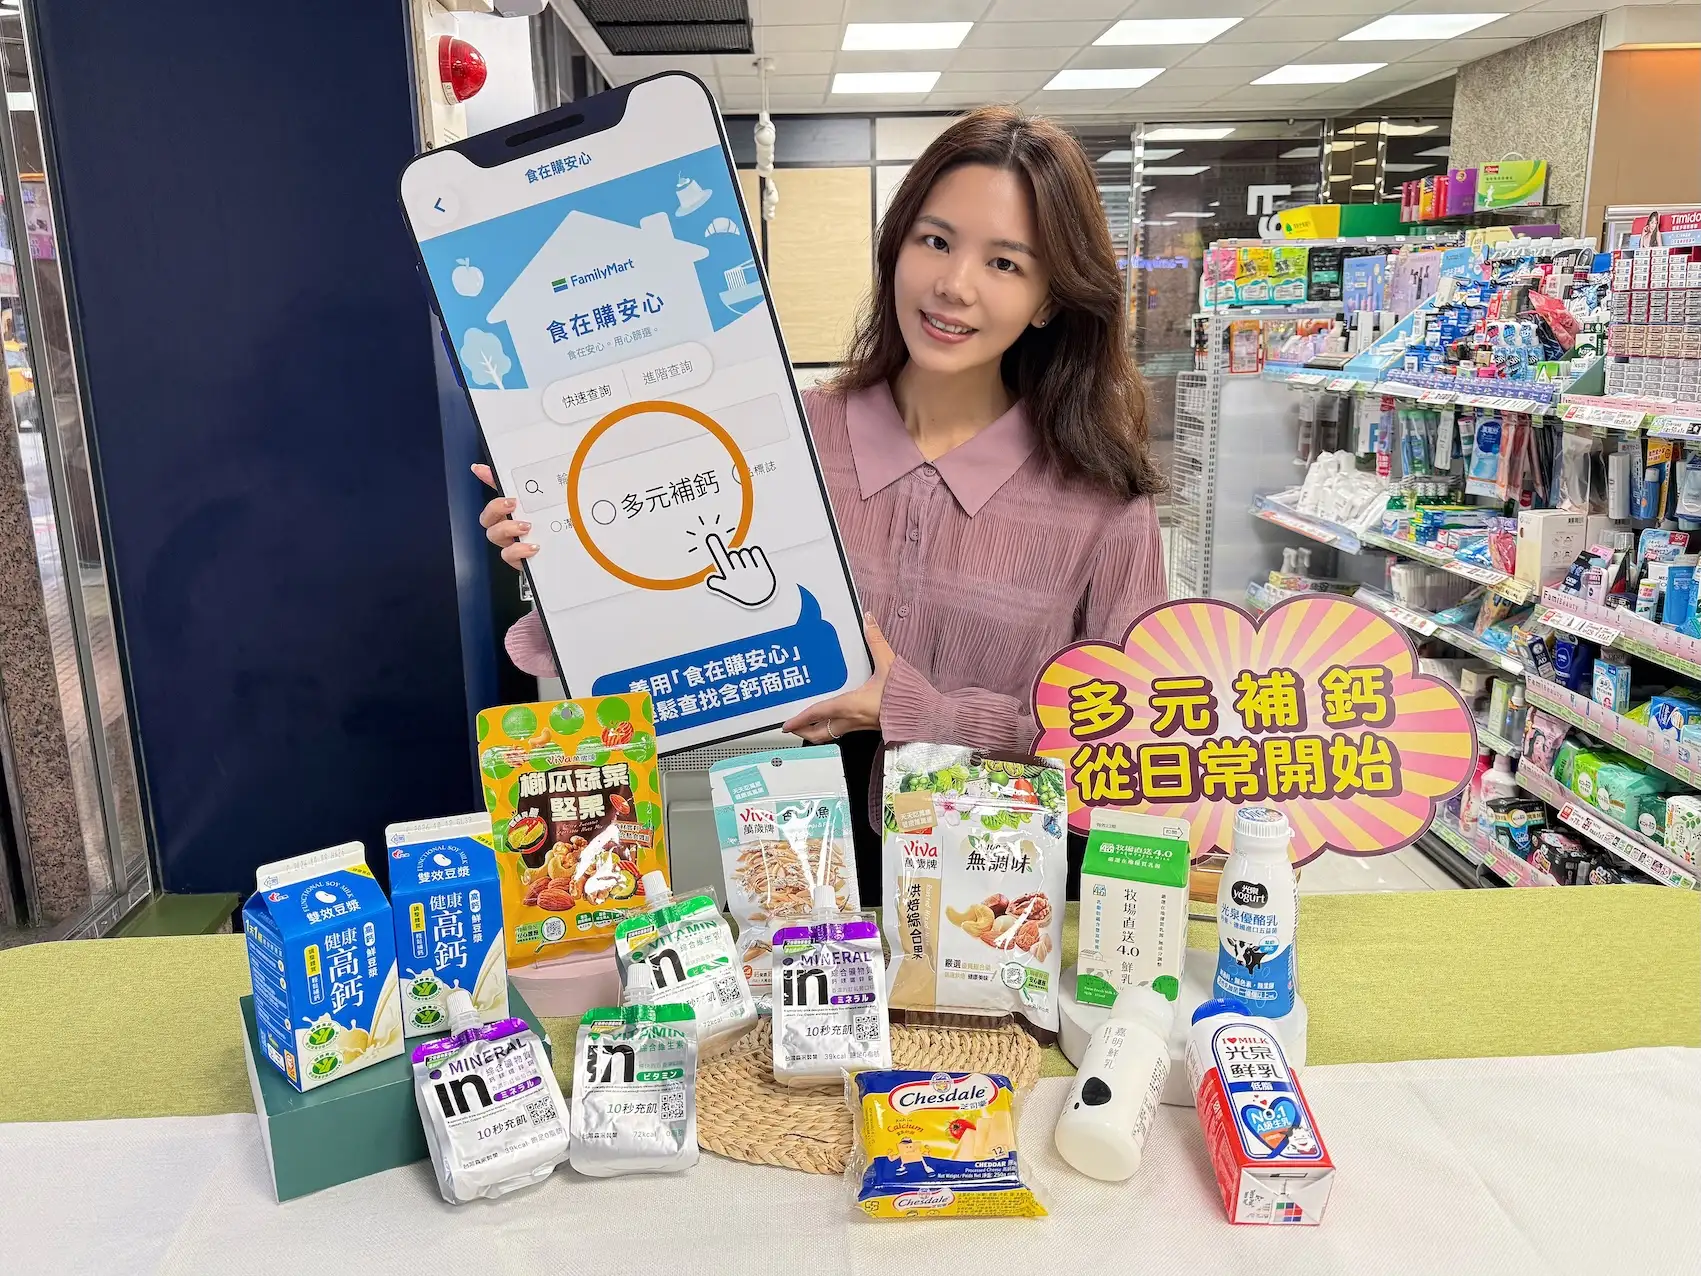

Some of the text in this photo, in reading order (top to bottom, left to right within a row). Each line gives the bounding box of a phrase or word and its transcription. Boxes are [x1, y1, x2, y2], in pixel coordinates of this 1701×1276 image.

[524, 151, 593, 184] 食在購安心
[570, 258, 635, 287] FamilyMart
[545, 291, 665, 344] 食在購安心
[566, 326, 660, 361] 食在安心。用心篩選。
[641, 359, 694, 386] 進階查詢
[561, 383, 613, 410] 快速查詢
[620, 469, 721, 519] 多元補鈣
[651, 664, 812, 726] 鬆查找含鈣商品!
[1069, 666, 1390, 739] 多元補鈣
[1073, 734, 1395, 802] 從日常開始
[519, 763, 629, 798] 櫛瓜蔬菜
[550, 794, 605, 822] 堅果
[417, 845, 446, 871] FUNCTIONAL
[447, 845, 461, 853] SOY
[966, 850, 1031, 874] 無調味
[1115, 843, 1173, 858] 牧場直送4.0
[417, 866, 471, 884] 雙效豆漿
[429, 892, 464, 911] 健康
[1233, 889, 1265, 904] yogurt
[1241, 885, 1259, 895] 光泉
[306, 899, 362, 925] 雙效豆漿
[906, 883, 923, 960] 烘焙綜合果
[1220, 903, 1279, 927] 光泉優酪乳
[324, 927, 358, 952] 健康
[430, 909, 468, 972] 高鈣
[647, 919, 717, 951] VITAMIN
[800, 951, 873, 966] MINERAL
[945, 958, 961, 969] 嚴選
[326, 946, 365, 1015] 高鈣
[1120, 961, 1134, 985] 鮮乳
[783, 968, 828, 1006] in
[837, 994, 869, 1004] ミネラル
[805, 1025, 852, 1038] 10秒充飢
[449, 1038, 527, 1076] MINERAL
[1102, 1027, 1128, 1070] 嘉明鮮乳
[1225, 1046, 1276, 1061] 光泉
[643, 1071, 677, 1080] ビタミン
[1229, 1063, 1283, 1079] 鮮乳
[434, 1073, 494, 1118] in
[500, 1080, 535, 1099] ミネラル
[899, 1086, 985, 1107] Chesdale
[1250, 1081, 1274, 1091] 低脂
[606, 1103, 658, 1114] 10秒充飢
[1250, 1105, 1287, 1124] NO.1
[477, 1114, 528, 1141] 10秒充飢
[887, 1122, 924, 1133] Calcium
[1256, 1117, 1291, 1133] A級生乳
[504, 1141, 529, 1154] 39kcal
[992, 1146, 1004, 1155] 12
[897, 1196, 949, 1208] Chesdale
